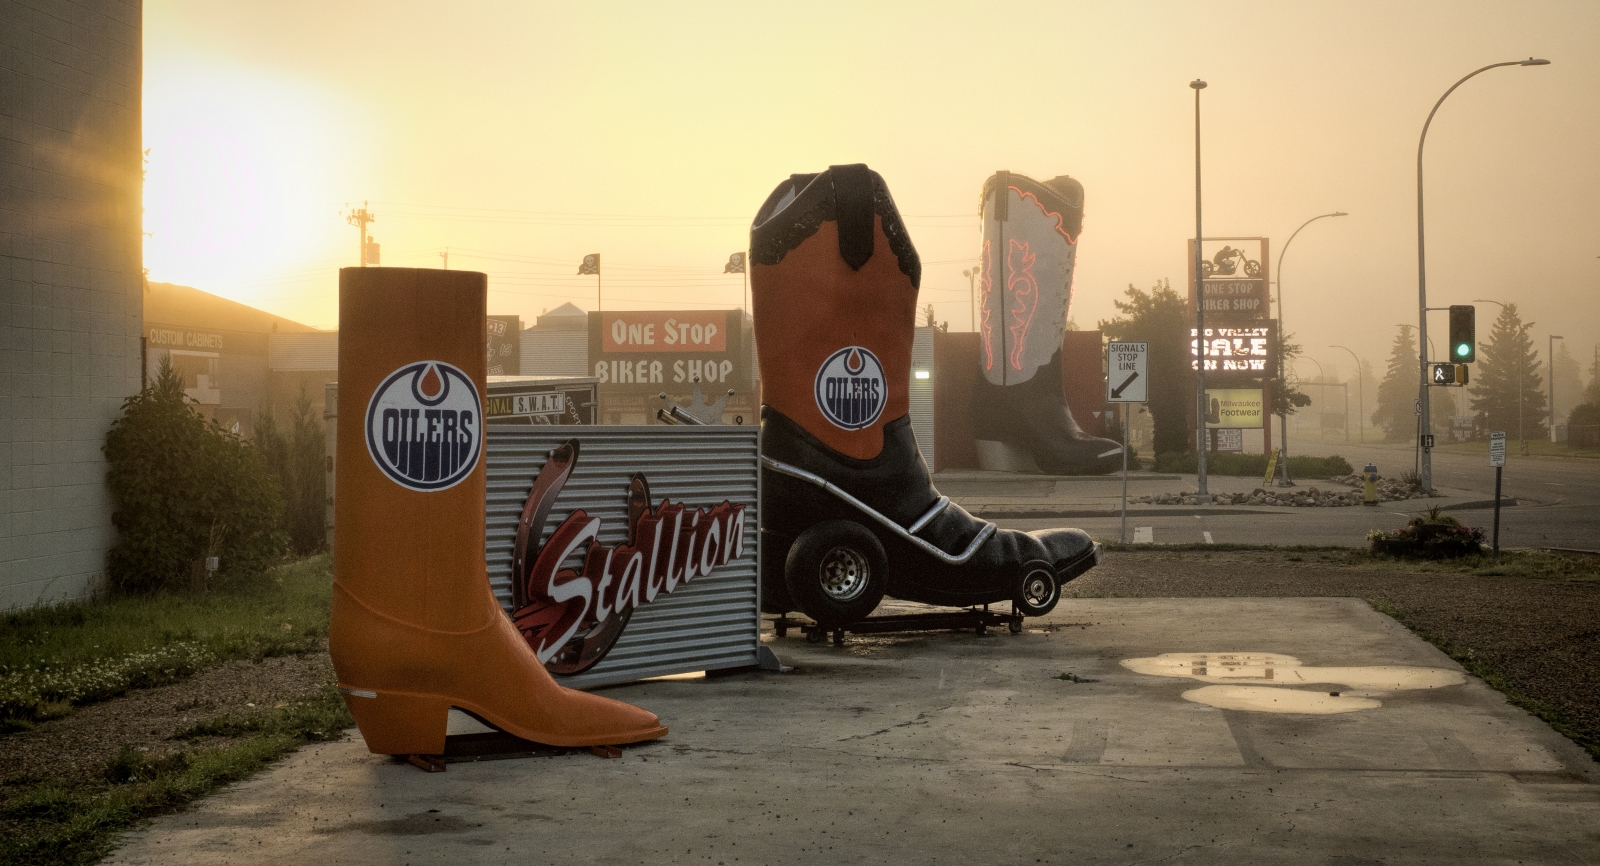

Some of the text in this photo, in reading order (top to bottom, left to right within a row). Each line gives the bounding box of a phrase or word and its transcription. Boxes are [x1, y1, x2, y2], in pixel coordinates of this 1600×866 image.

[1204, 283, 1253, 294] ONE STOP
[1203, 299, 1260, 310] IKER SHOP
[1190, 328, 1268, 336] BG VALLEY
[150, 329, 223, 348] CUSTOM CABINETS
[1111, 344, 1145, 352] SIGNALS
[1191, 338, 1266, 356] SALE
[1118, 353, 1138, 361] STOP
[1192, 360, 1266, 370] ON NOW
[595, 360, 733, 384] BIKER SHOP
[518, 395, 558, 412] S.W.A.T.
[536, 508, 744, 665] Stallion
